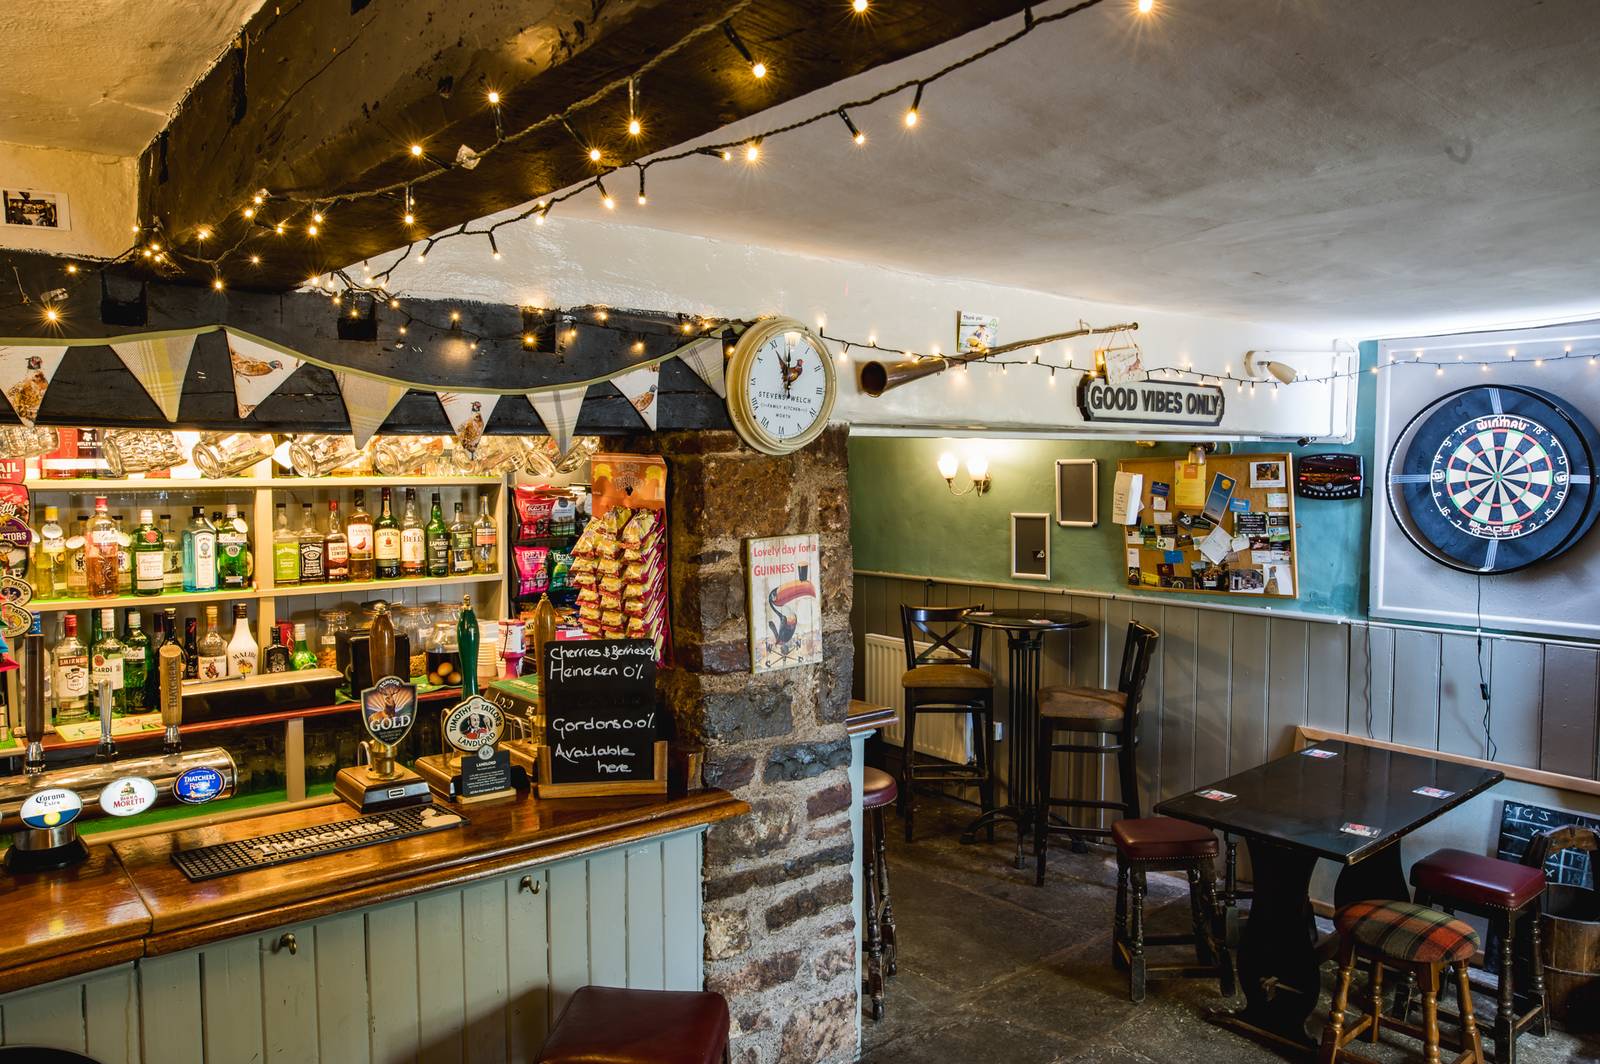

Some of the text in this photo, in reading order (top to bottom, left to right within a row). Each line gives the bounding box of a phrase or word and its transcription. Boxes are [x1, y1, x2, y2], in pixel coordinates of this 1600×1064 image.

[790, 396, 812, 404] WELCH
[1091, 386, 1219, 416] GOOD VIBES ONLY
[523, 551, 546, 561] REAL
[753, 547, 779, 558] Lovely
[781, 545, 796, 556] day
[799, 543, 810, 553] for
[754, 563, 795, 577] GUINNESS
[550, 645, 601, 660] Cherries
[550, 661, 644, 682] Heineken 0%
[370, 714, 411, 732] GOLD
[449, 705, 472, 732] TIMOTHY
[481, 704, 502, 727] TAYLOR'S
[552, 717, 621, 740] Gordons
[458, 732, 496, 748] LANDLORD
[555, 743, 636, 763] Available
[597, 760, 632, 773] here
[184, 773, 216, 783] THATCHERS
[35, 793, 65, 804] Corona
[113, 797, 145, 809] MORETTI
[253, 819, 397, 856] THATCHERS
